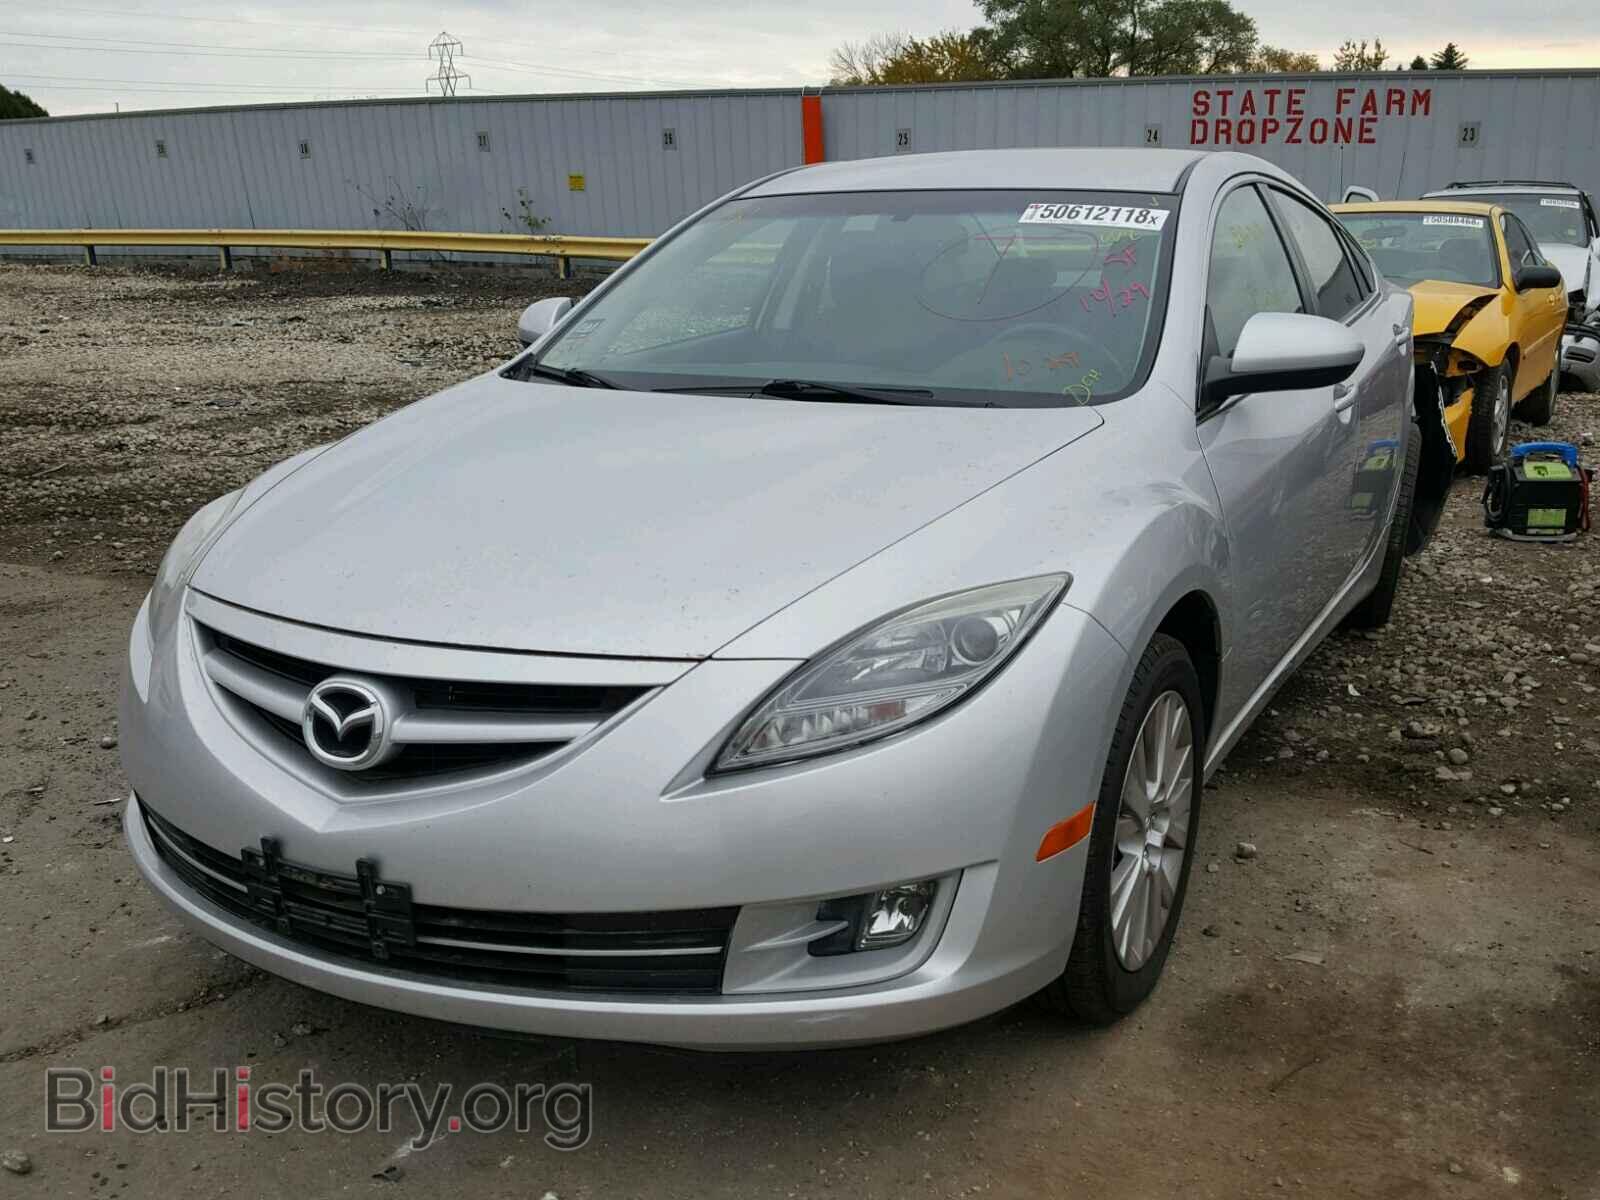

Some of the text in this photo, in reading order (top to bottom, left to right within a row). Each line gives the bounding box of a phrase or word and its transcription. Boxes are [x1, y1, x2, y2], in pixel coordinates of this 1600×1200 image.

[1192, 88, 1432, 116] STATE FARM
[898, 132, 909, 146] 25
[1146, 128, 1159, 143] 24
[1190, 117, 1378, 145] DROPZONE
[1462, 127, 1476, 143] 23
